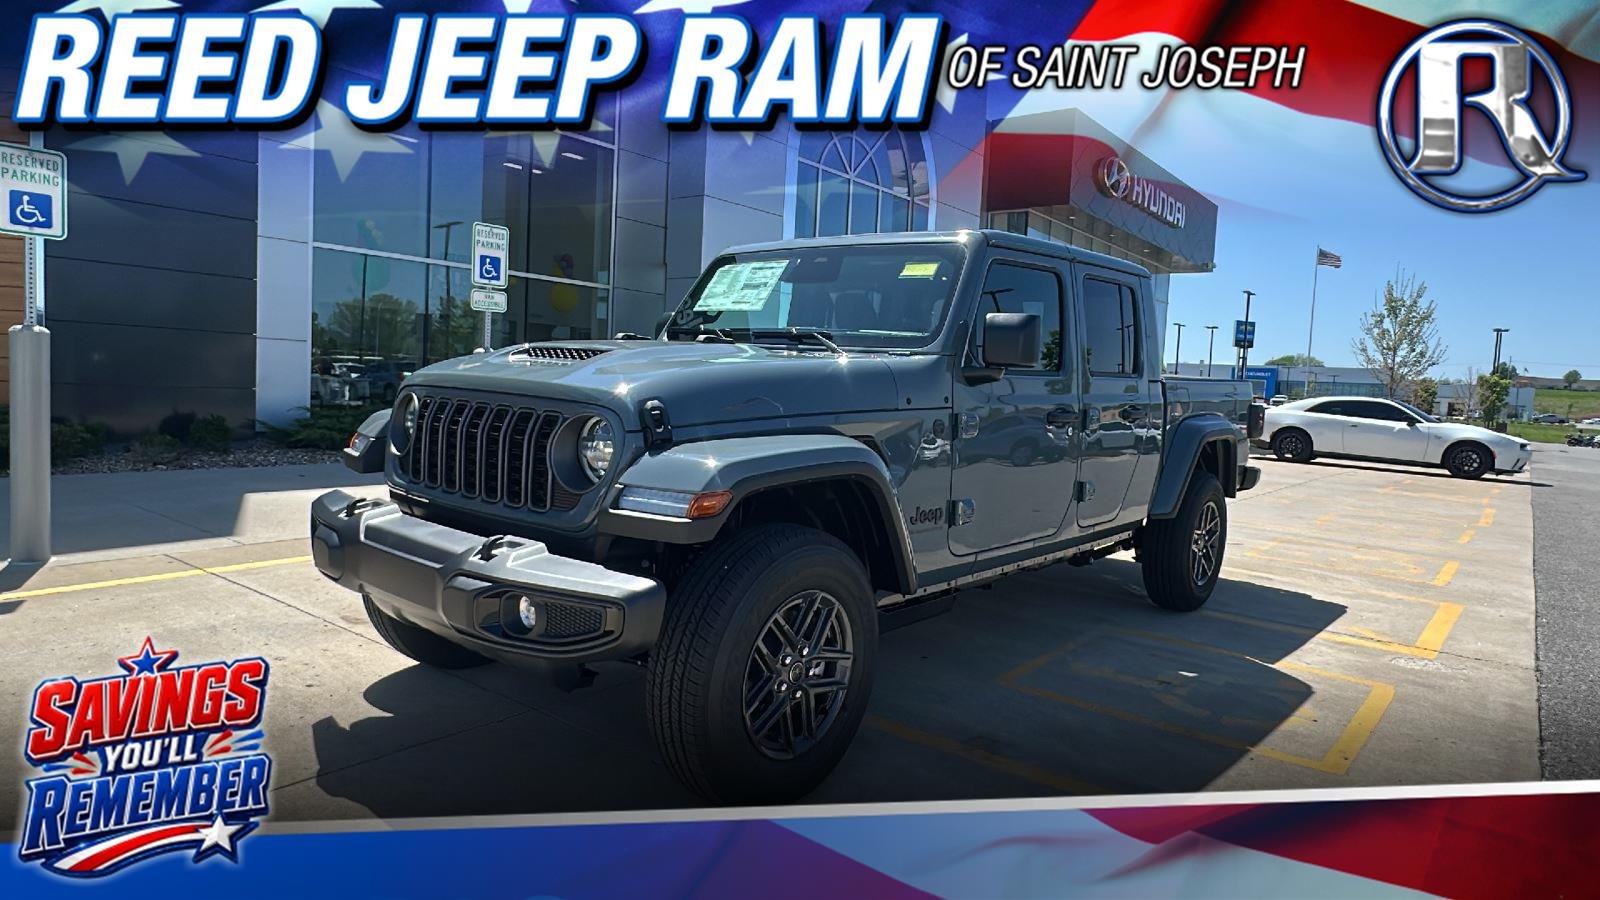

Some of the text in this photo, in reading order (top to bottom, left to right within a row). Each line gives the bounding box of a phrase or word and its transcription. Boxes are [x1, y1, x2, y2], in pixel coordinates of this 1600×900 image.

[1, 151, 59, 172] RESERVED
[1, 166, 59, 187] PARKING
[1132, 174, 1186, 229] HYUNDAI
[476, 228, 505, 241] RESERVED
[476, 239, 505, 251] PARKING
[909, 505, 943, 525] Jeep
